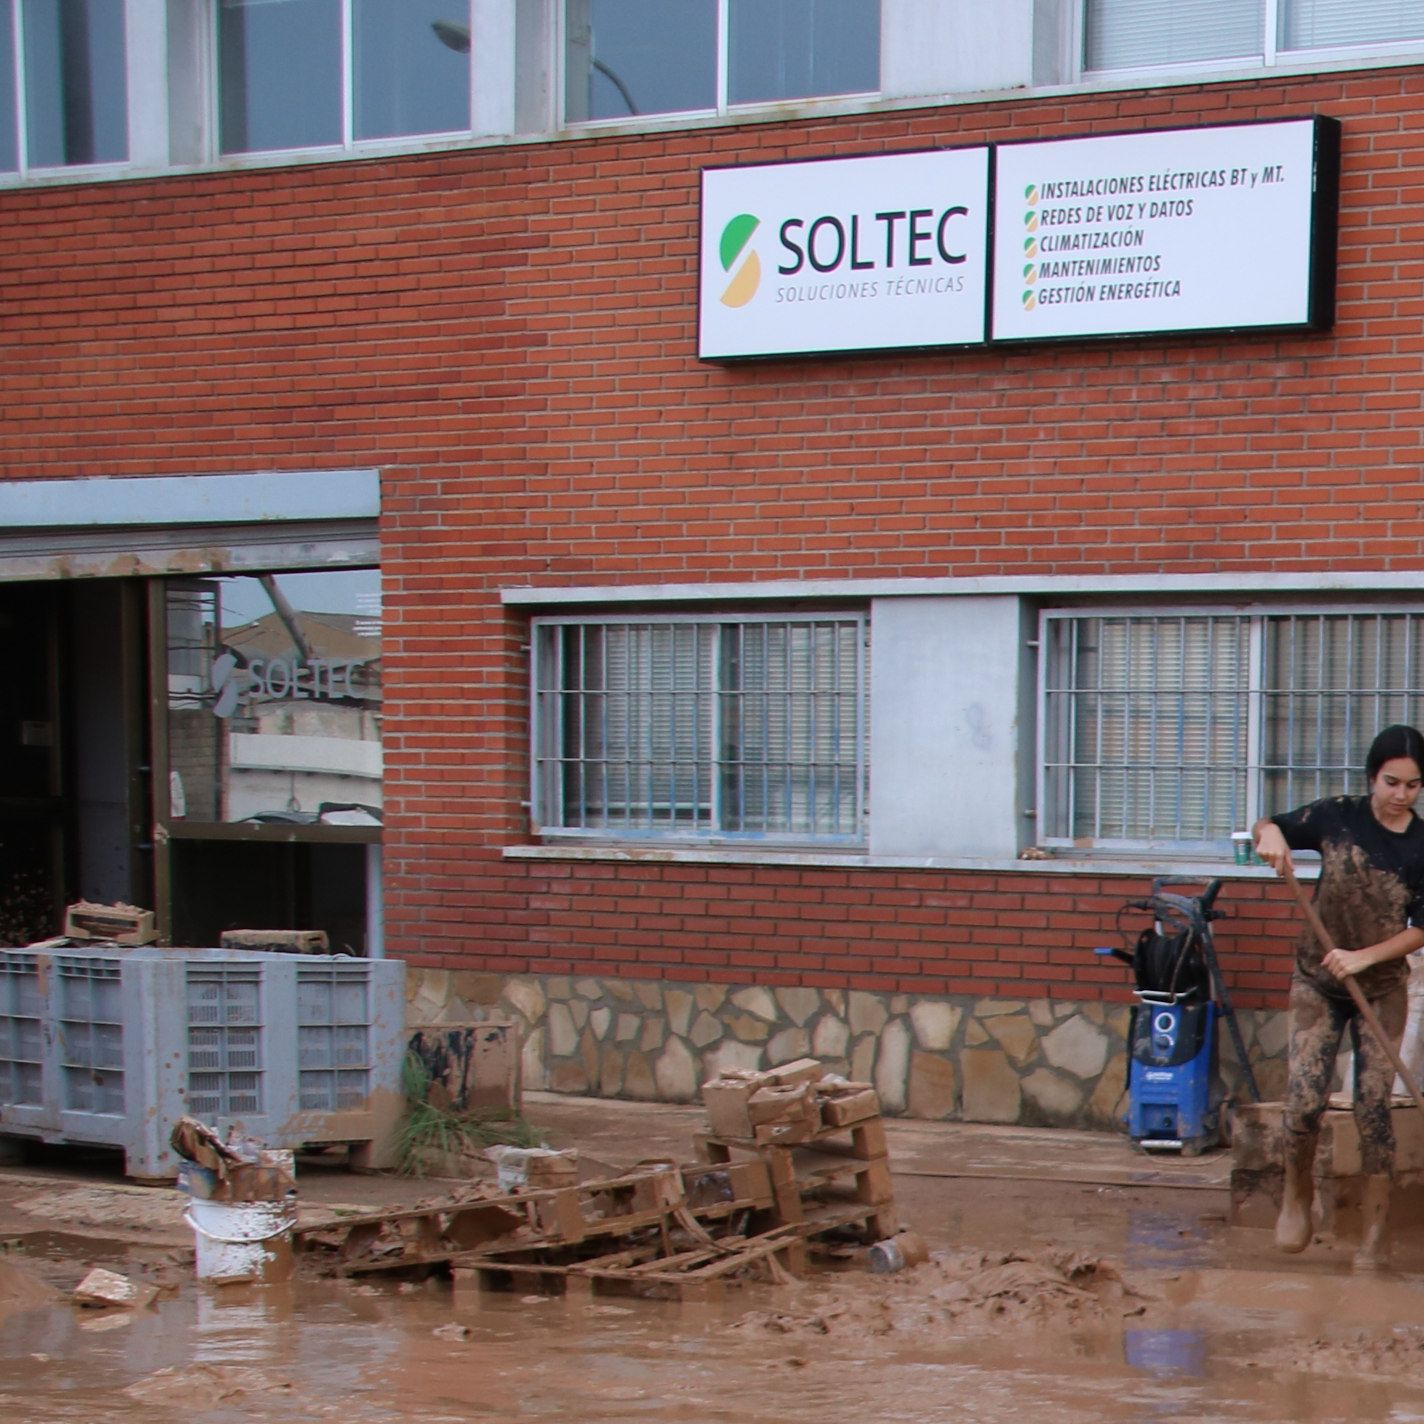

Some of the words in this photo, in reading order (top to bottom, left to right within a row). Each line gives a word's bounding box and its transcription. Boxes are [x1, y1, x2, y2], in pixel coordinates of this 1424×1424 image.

[1041, 176, 1145, 200] INSTALACIONES
[1149, 168, 1226, 192] ELÉCTRICAS
[1230, 168, 1248, 186] BT
[1251, 173, 1258, 188] y
[1262, 165, 1285, 184] MT.
[1041, 207, 1081, 226] REDES
[1086, 205, 1103, 223] DE
[1108, 203, 1134, 222] VOZ
[1138, 203, 1148, 220] Y
[1150, 199, 1194, 219] DATOS
[778, 206, 969, 276] SOLTEC
[1040, 226, 1144, 253] CLIMATIZACIÓN
[1038, 255, 1162, 279] MANTENIMIENTOS
[776, 281, 878, 303] SOLUCIONES
[886, 276, 965, 296] TÉCNICAS
[1038, 281, 1096, 305] GESTIÓN
[1099, 277, 1181, 302] ENERGÉTICA
[249, 658, 366, 699] SOLTEC
